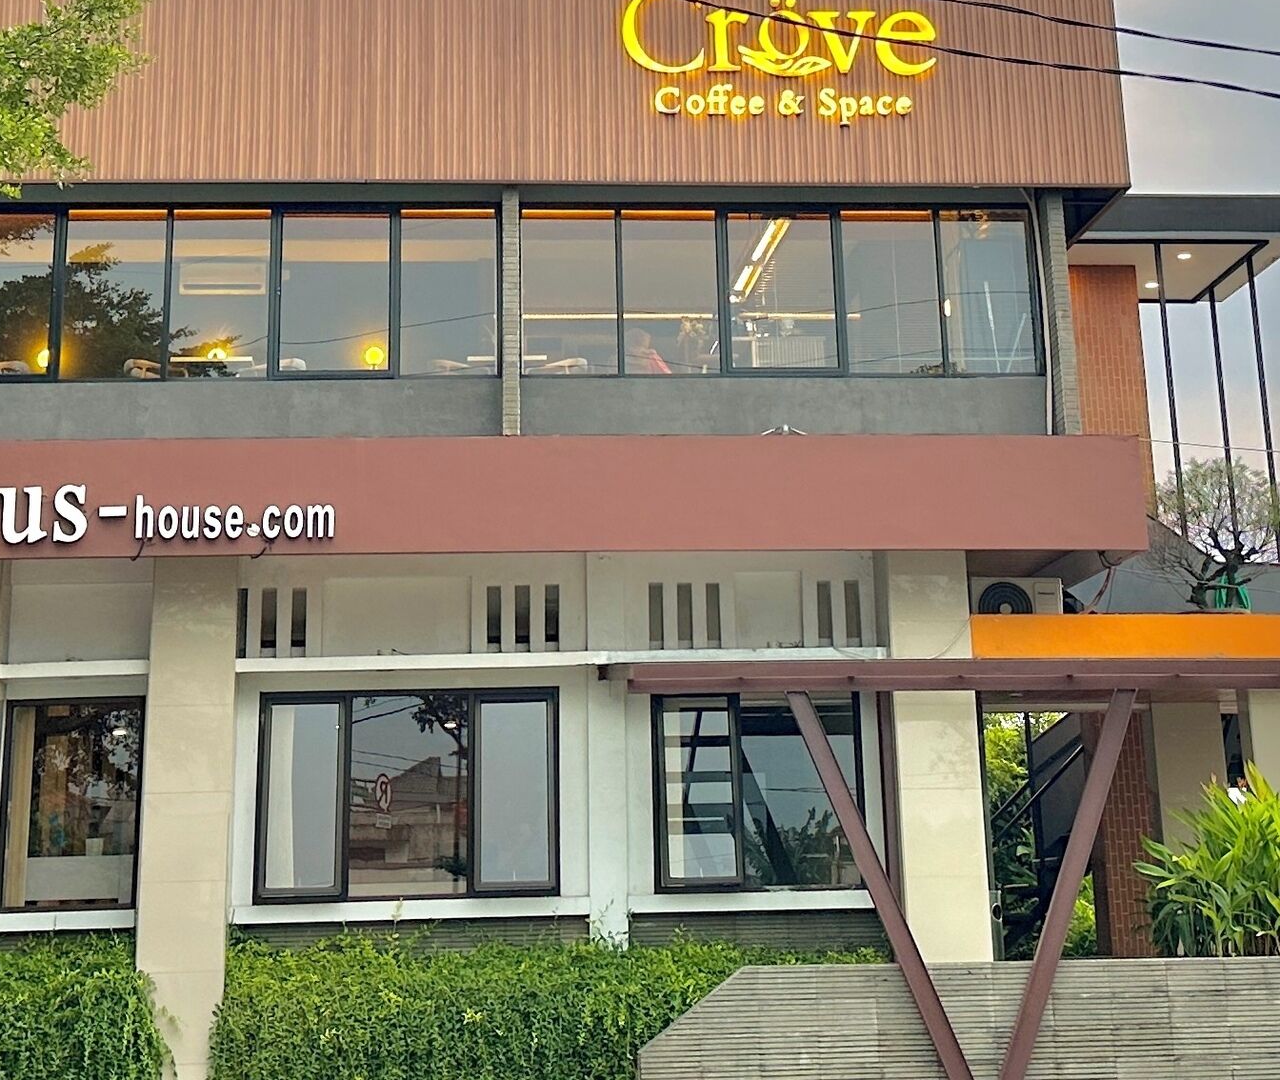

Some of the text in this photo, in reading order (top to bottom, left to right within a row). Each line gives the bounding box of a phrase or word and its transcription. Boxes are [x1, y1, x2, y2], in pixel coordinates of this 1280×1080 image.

[654, 84, 913, 127] Coffee & Space
